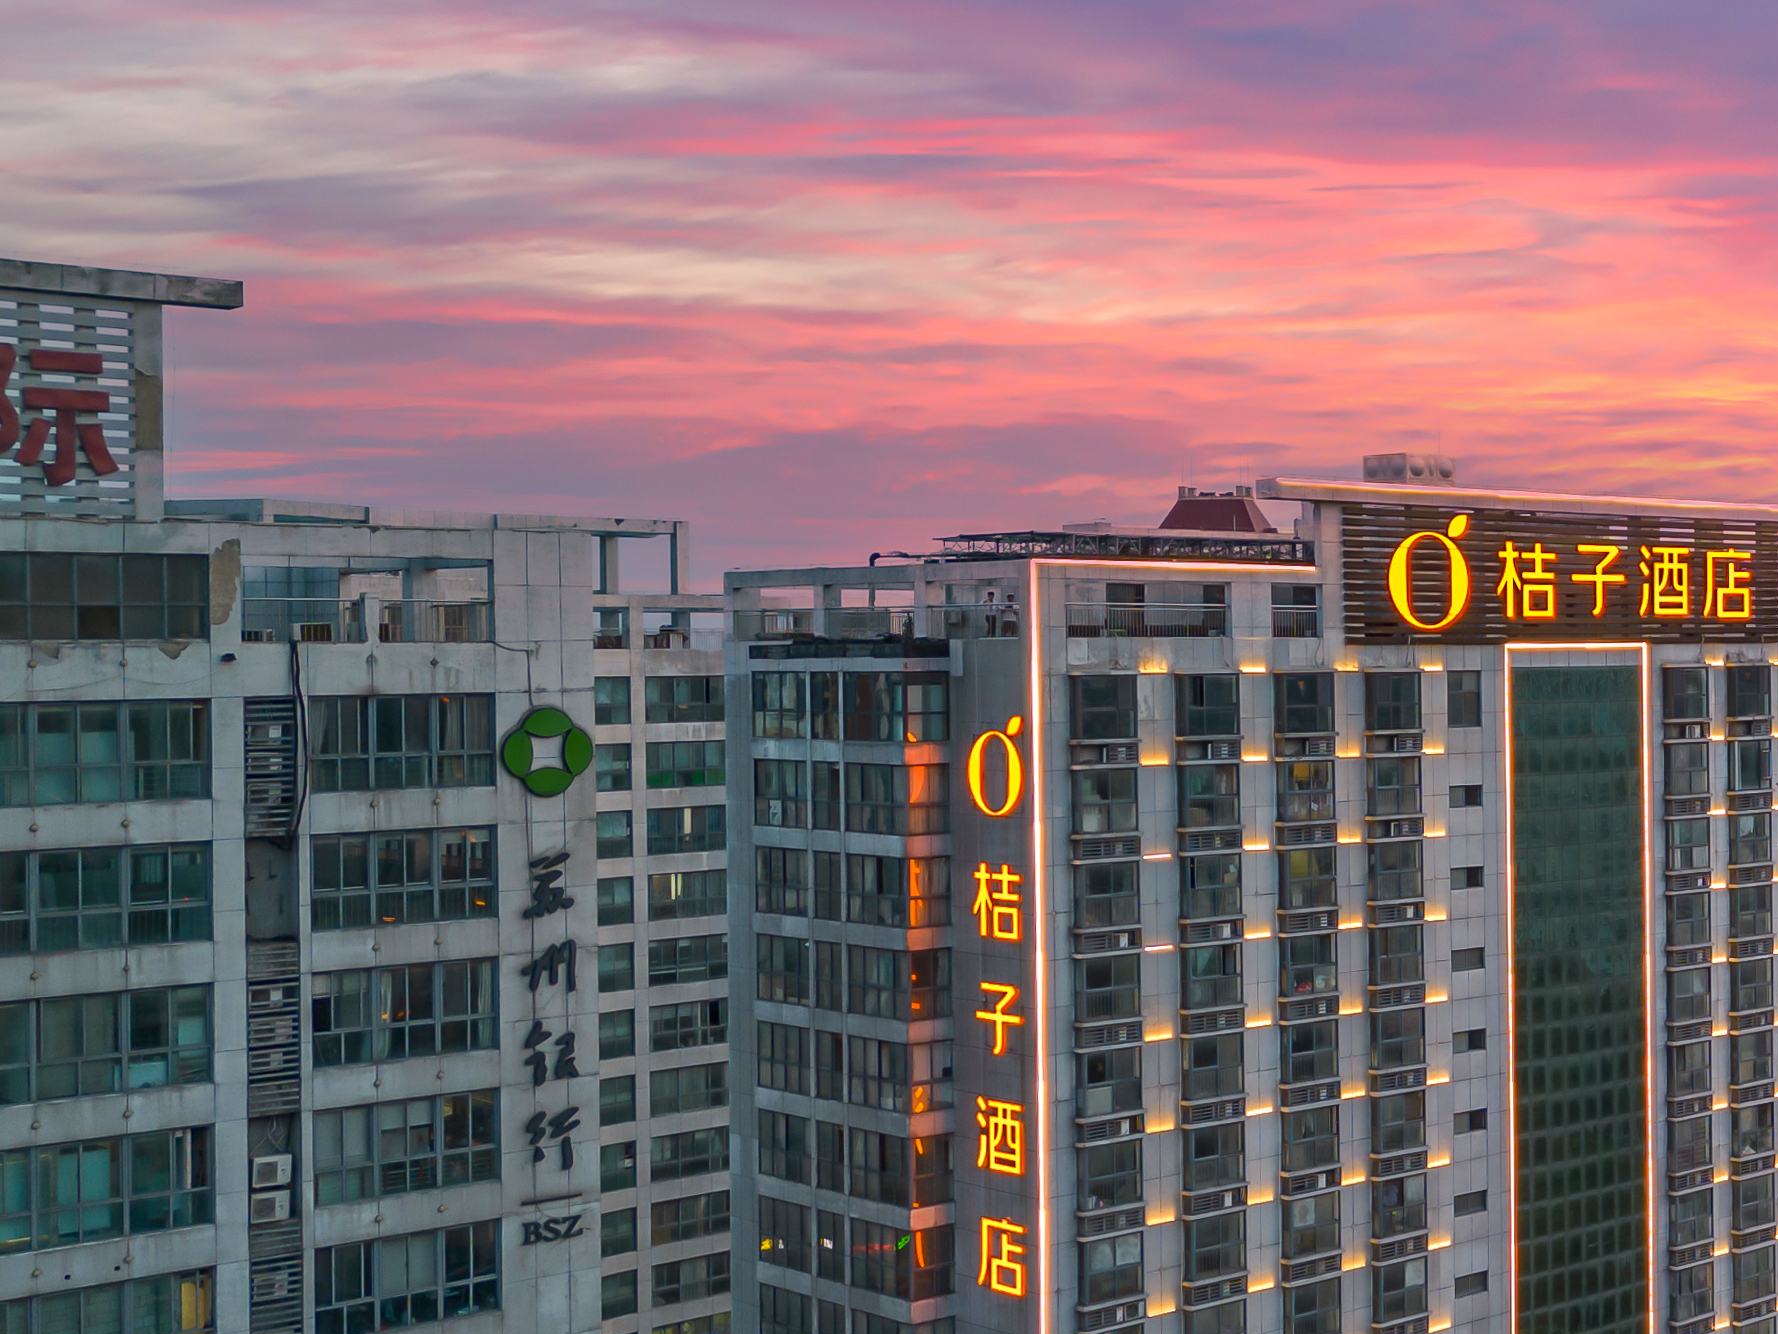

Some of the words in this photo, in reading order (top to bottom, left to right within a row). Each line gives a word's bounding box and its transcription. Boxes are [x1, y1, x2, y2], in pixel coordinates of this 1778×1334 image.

[1497, 541, 1753, 620] 桔子酒店
[973, 861, 1027, 1297] 桔子酒店
[521, 1214, 584, 1246] BSZ
